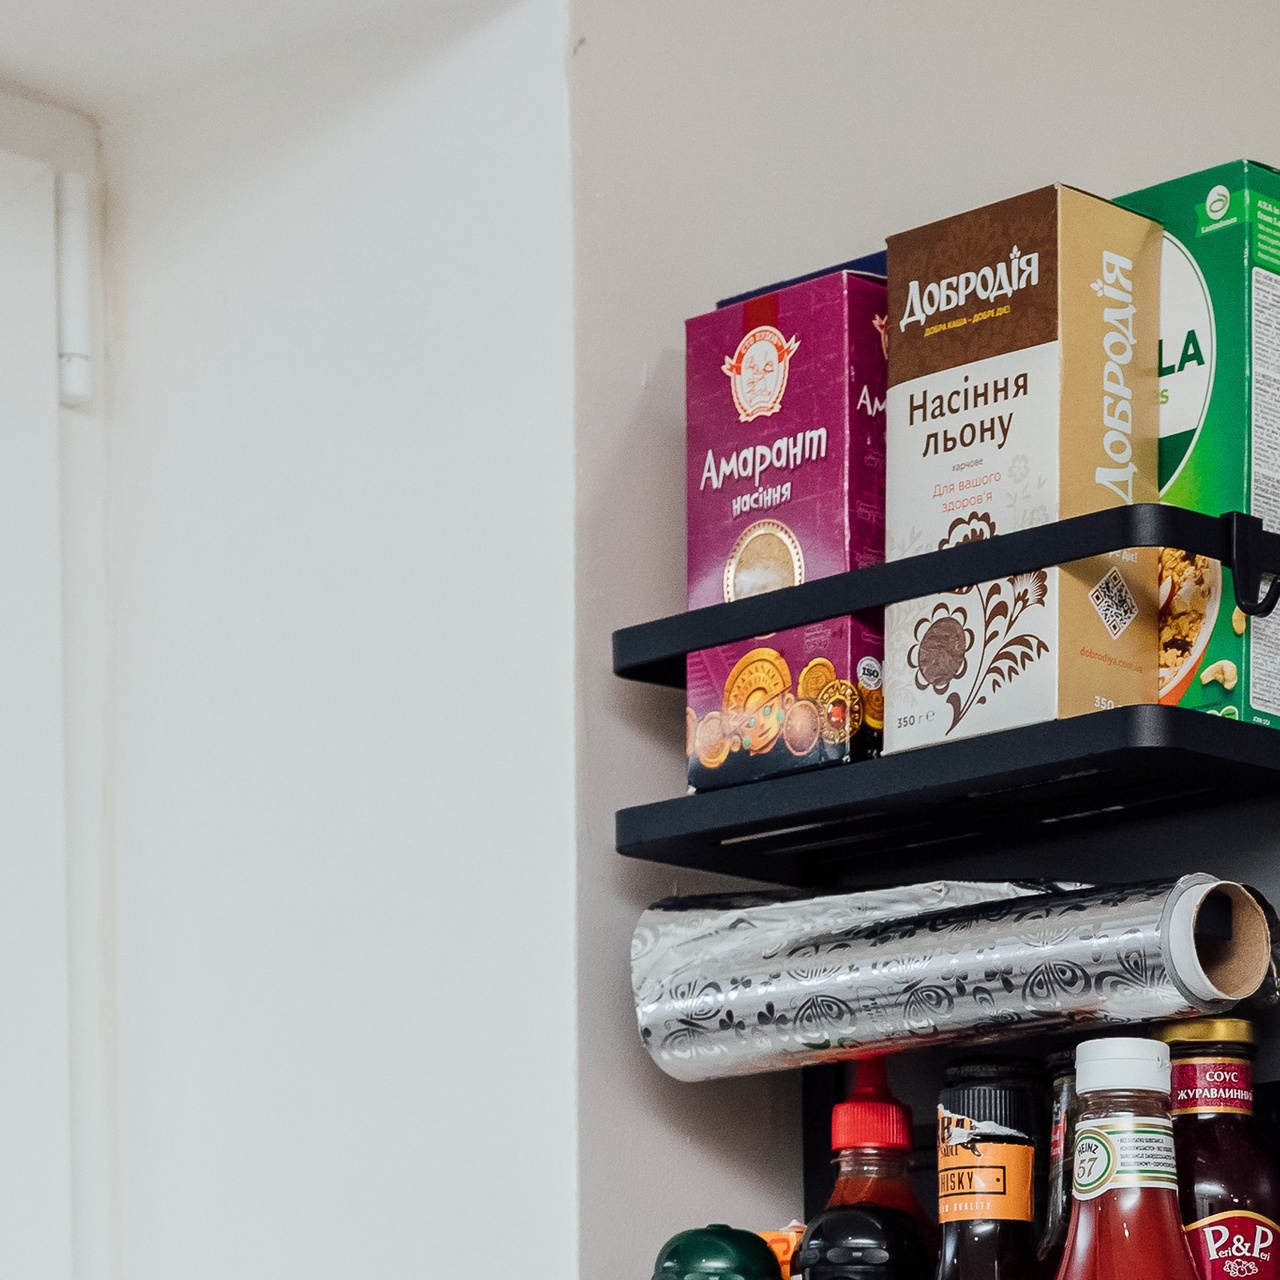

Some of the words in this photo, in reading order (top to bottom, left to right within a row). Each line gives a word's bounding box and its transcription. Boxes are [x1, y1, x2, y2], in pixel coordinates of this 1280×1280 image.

[909, 373, 1028, 426] Насіння
[922, 412, 1013, 457] льону
[700, 427, 827, 490] Амарант
[932, 484, 955, 498] Для
[958, 472, 1001, 491] вашого
[732, 482, 791, 516] насіння
[897, 715, 915, 729] 350
[1205, 1071, 1239, 1082] СОУС
[1078, 1143, 1099, 1157] HEINZ
[1077, 1157, 1099, 1179] 57
[940, 1171, 974, 1193] HISKY
